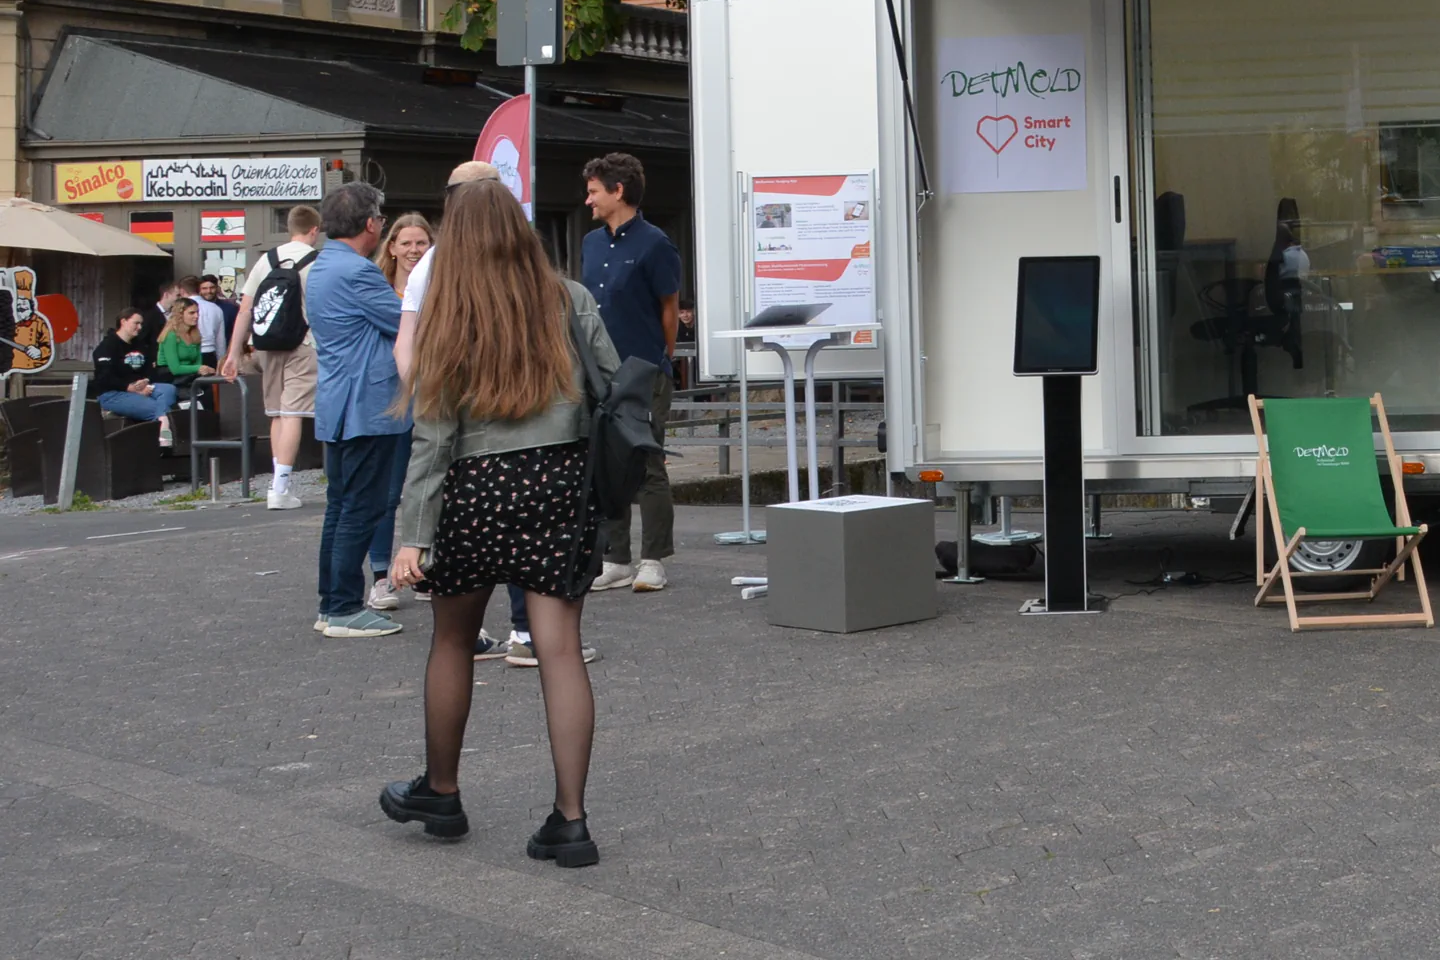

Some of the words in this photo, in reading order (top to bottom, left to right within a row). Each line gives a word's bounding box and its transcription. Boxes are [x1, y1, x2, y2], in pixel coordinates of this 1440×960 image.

[1024, 116, 1071, 129] Smart
[1024, 134, 1056, 151] City
[231, 163, 318, 180] Orientalische
[64, 164, 125, 200] Sinalco
[232, 181, 319, 198] Spezialitäten
